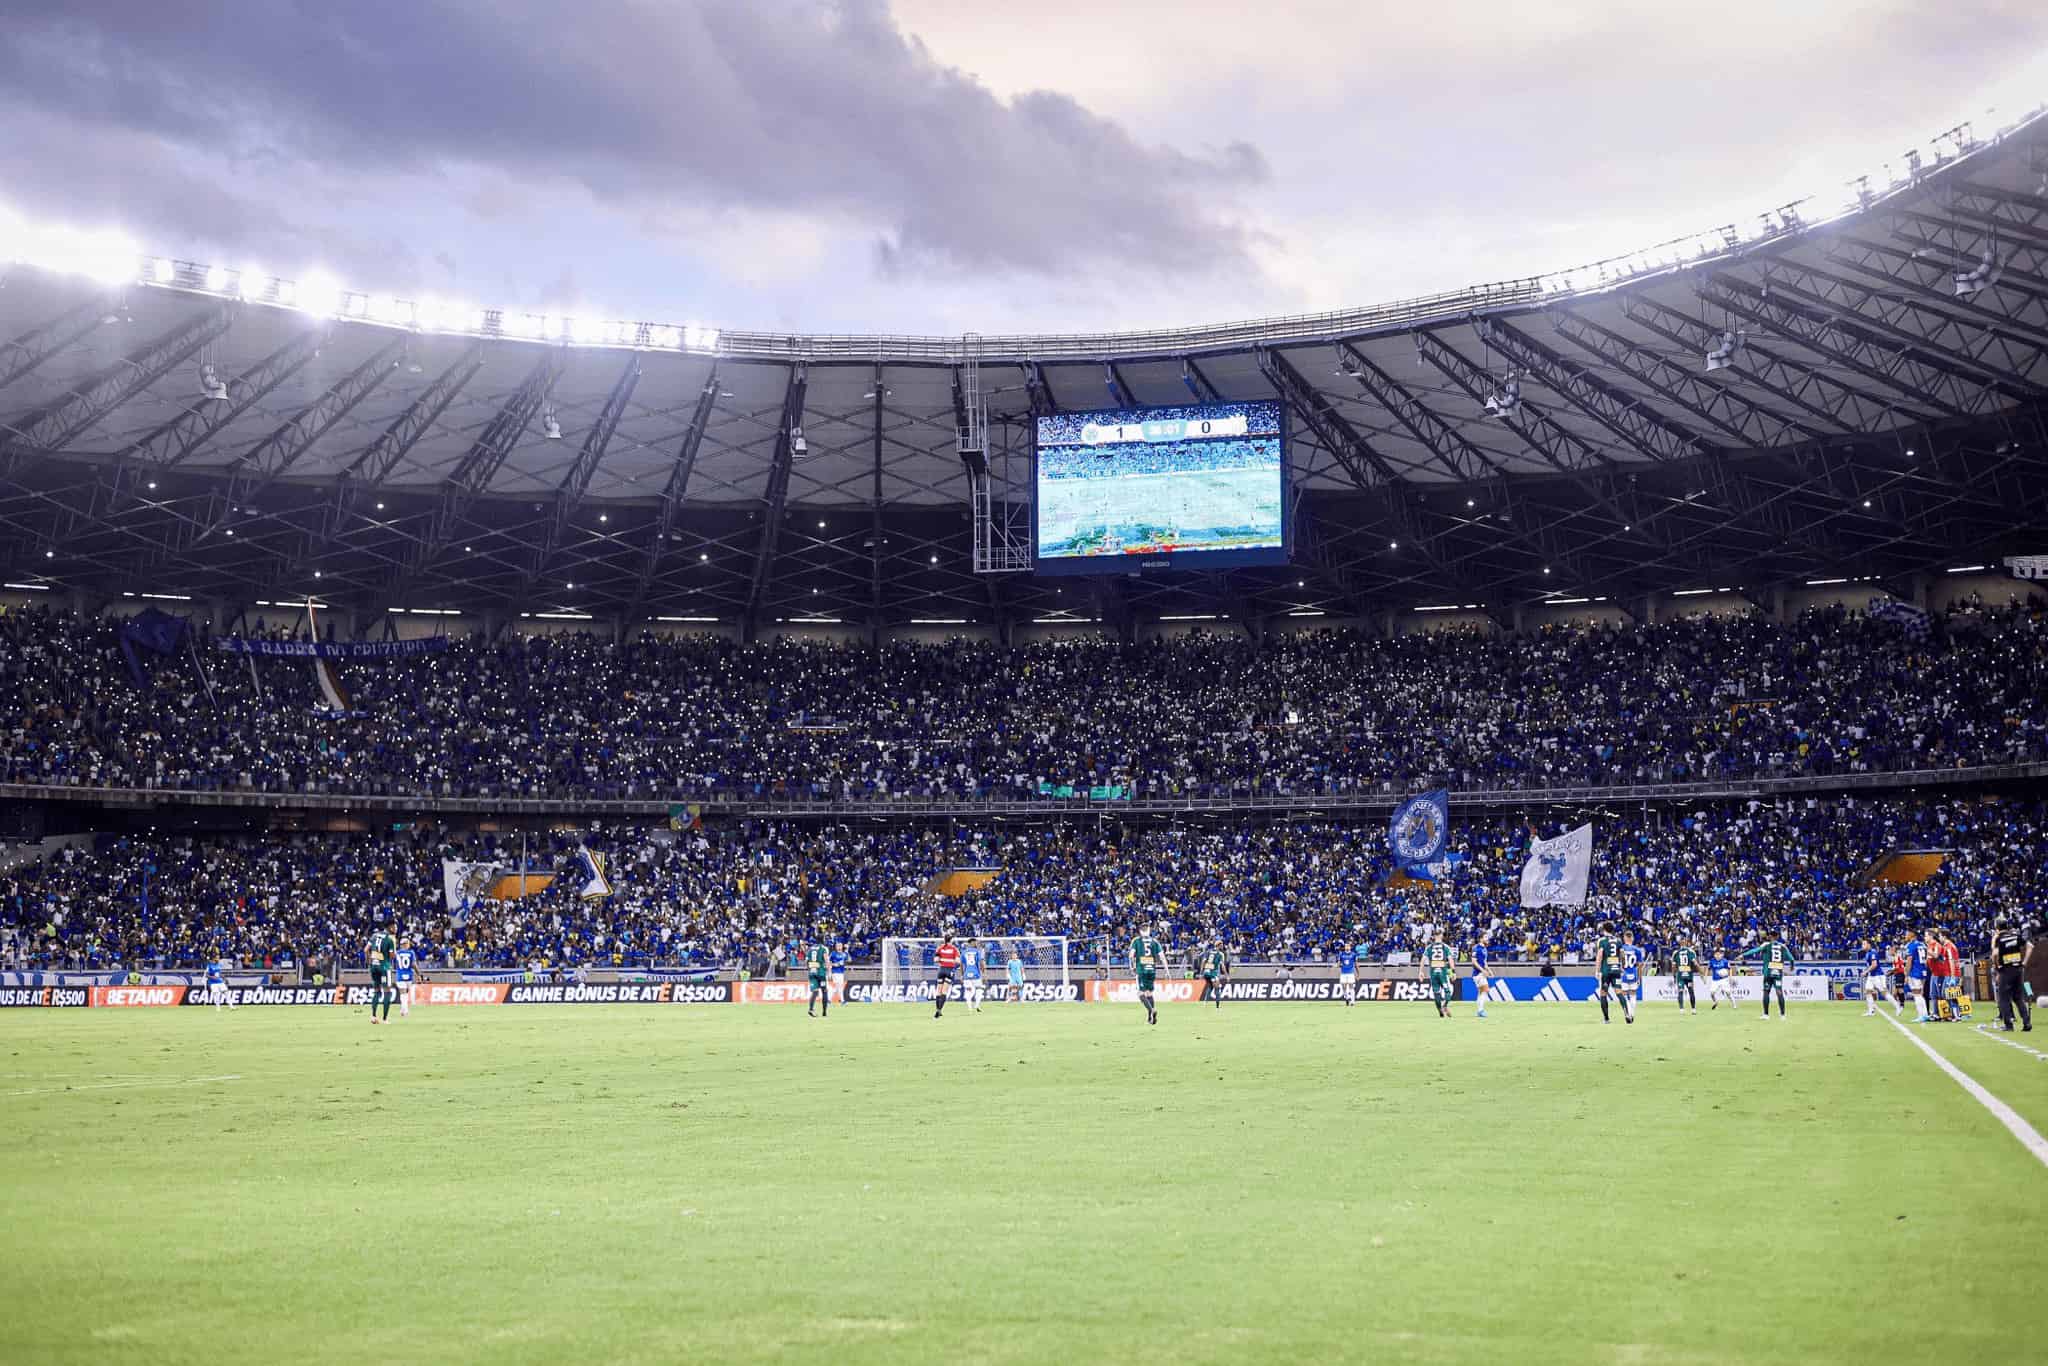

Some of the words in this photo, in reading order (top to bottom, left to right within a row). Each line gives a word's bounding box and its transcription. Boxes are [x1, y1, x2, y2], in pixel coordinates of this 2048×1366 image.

[1117, 427, 1123, 439] 1
[1201, 421, 1211, 434] 0
[1143, 942, 1151, 957] 5
[1610, 943, 1617, 957] 3
[398, 955, 410, 969] 10
[1624, 954, 1637, 968] 10
[16, 989, 31, 1005] DE
[31, 986, 51, 1006] ATÉ
[52, 988, 86, 1008] R$500
[107, 988, 174, 1006] BETANO
[242, 985, 295, 1005] BÔNUS
[295, 988, 316, 1004] DE
[316, 985, 347, 1004] ATÉ
[430, 986, 497, 1003] BETANO
[511, 987, 563, 1003] GANHE
[565, 982, 618, 1003] BÔNUS
[618, 986, 640, 1001] DE
[640, 982, 672, 1002] ATÉ
[673, 984, 727, 1004] R$500
[763, 986, 829, 1002] BETA
[849, 984, 905, 1001] GANHE
[905, 980, 962, 1001] BÔNS
[1023, 983, 1079, 1001] R$500
[1270, 979, 1329, 1000] BÔNUS
[1356, 978, 1393, 1000] ATÉ
[1394, 981, 1454, 1001] R$5
